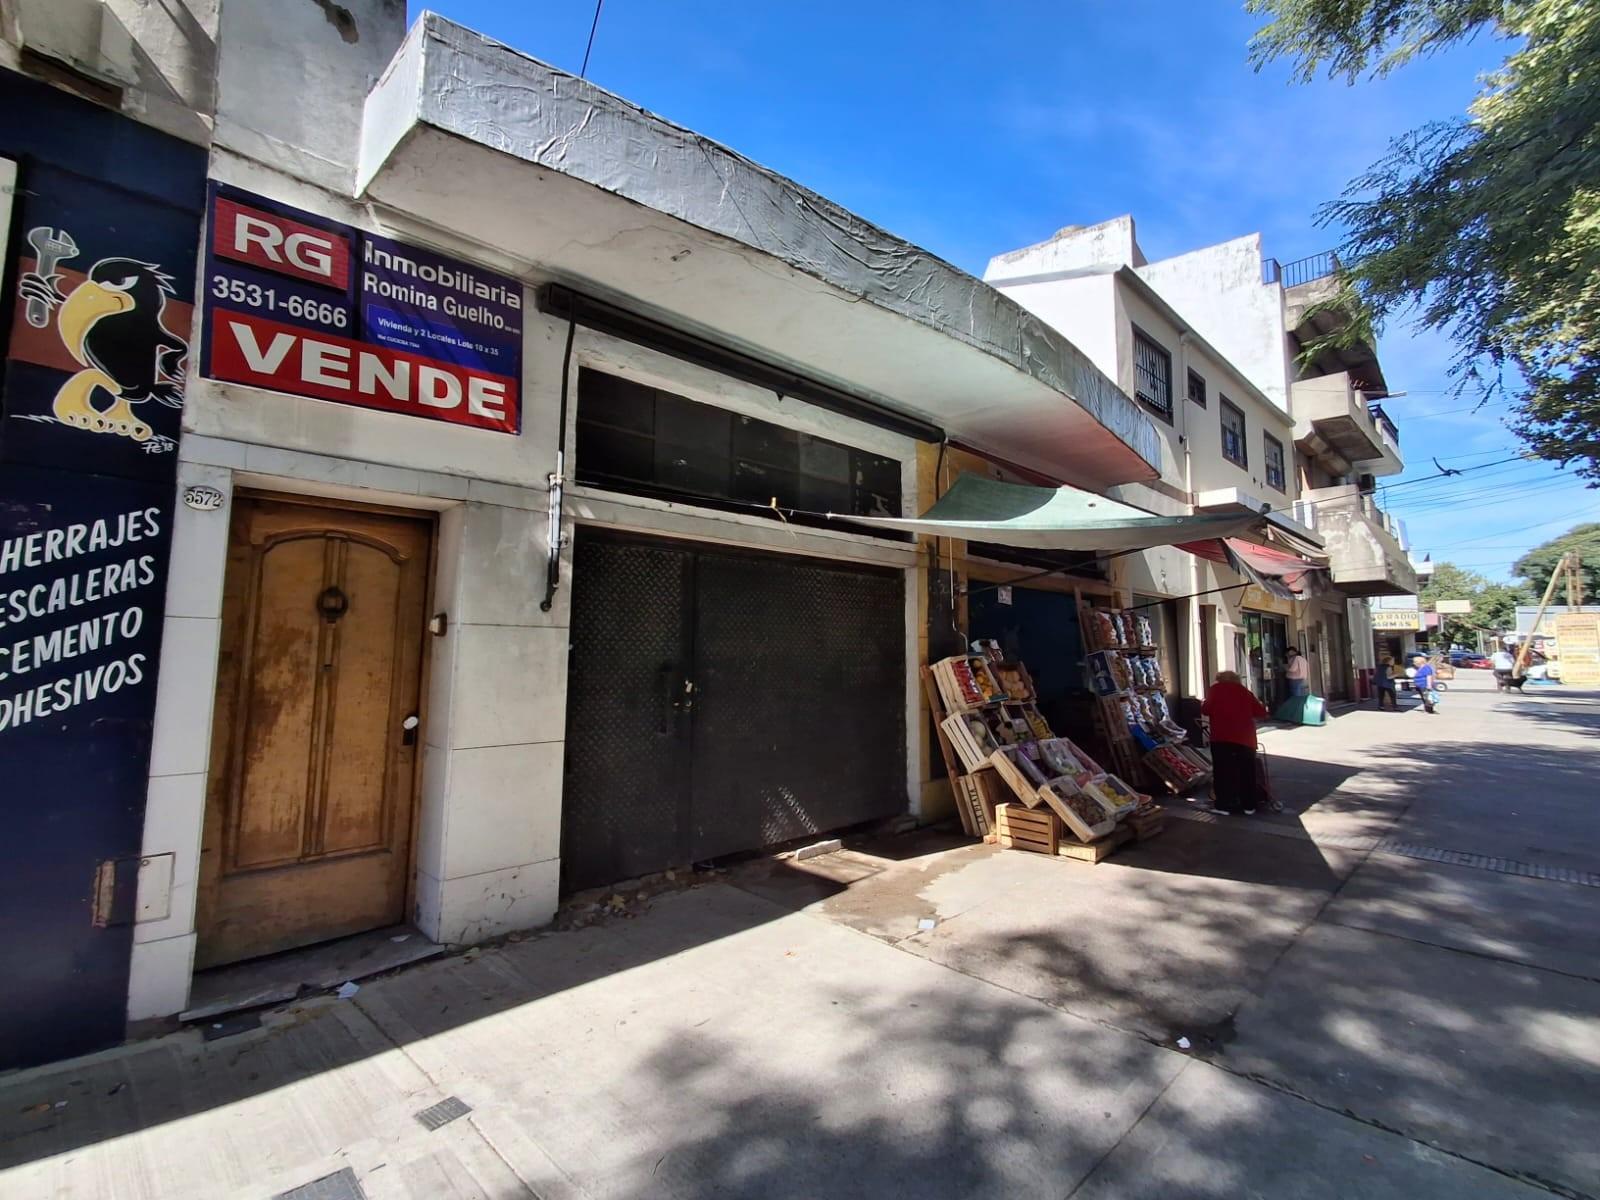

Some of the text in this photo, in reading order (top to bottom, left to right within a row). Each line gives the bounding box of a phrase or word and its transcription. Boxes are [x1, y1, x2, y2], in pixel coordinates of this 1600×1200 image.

[234, 212, 333, 278] RG
[364, 240, 521, 310] Inmobiliaria
[212, 274, 347, 329] 3531-6666
[363, 271, 504, 330] Romina Guelho
[378, 317, 412, 334] Vivienda
[414, 328, 419, 337] y
[420, 328, 427, 337] 2
[427, 331, 456, 346] Locales
[228, 320, 507, 421] VENDE
[184, 490, 221, 507] 5572
[0, 507, 161, 574] HERRAJES
